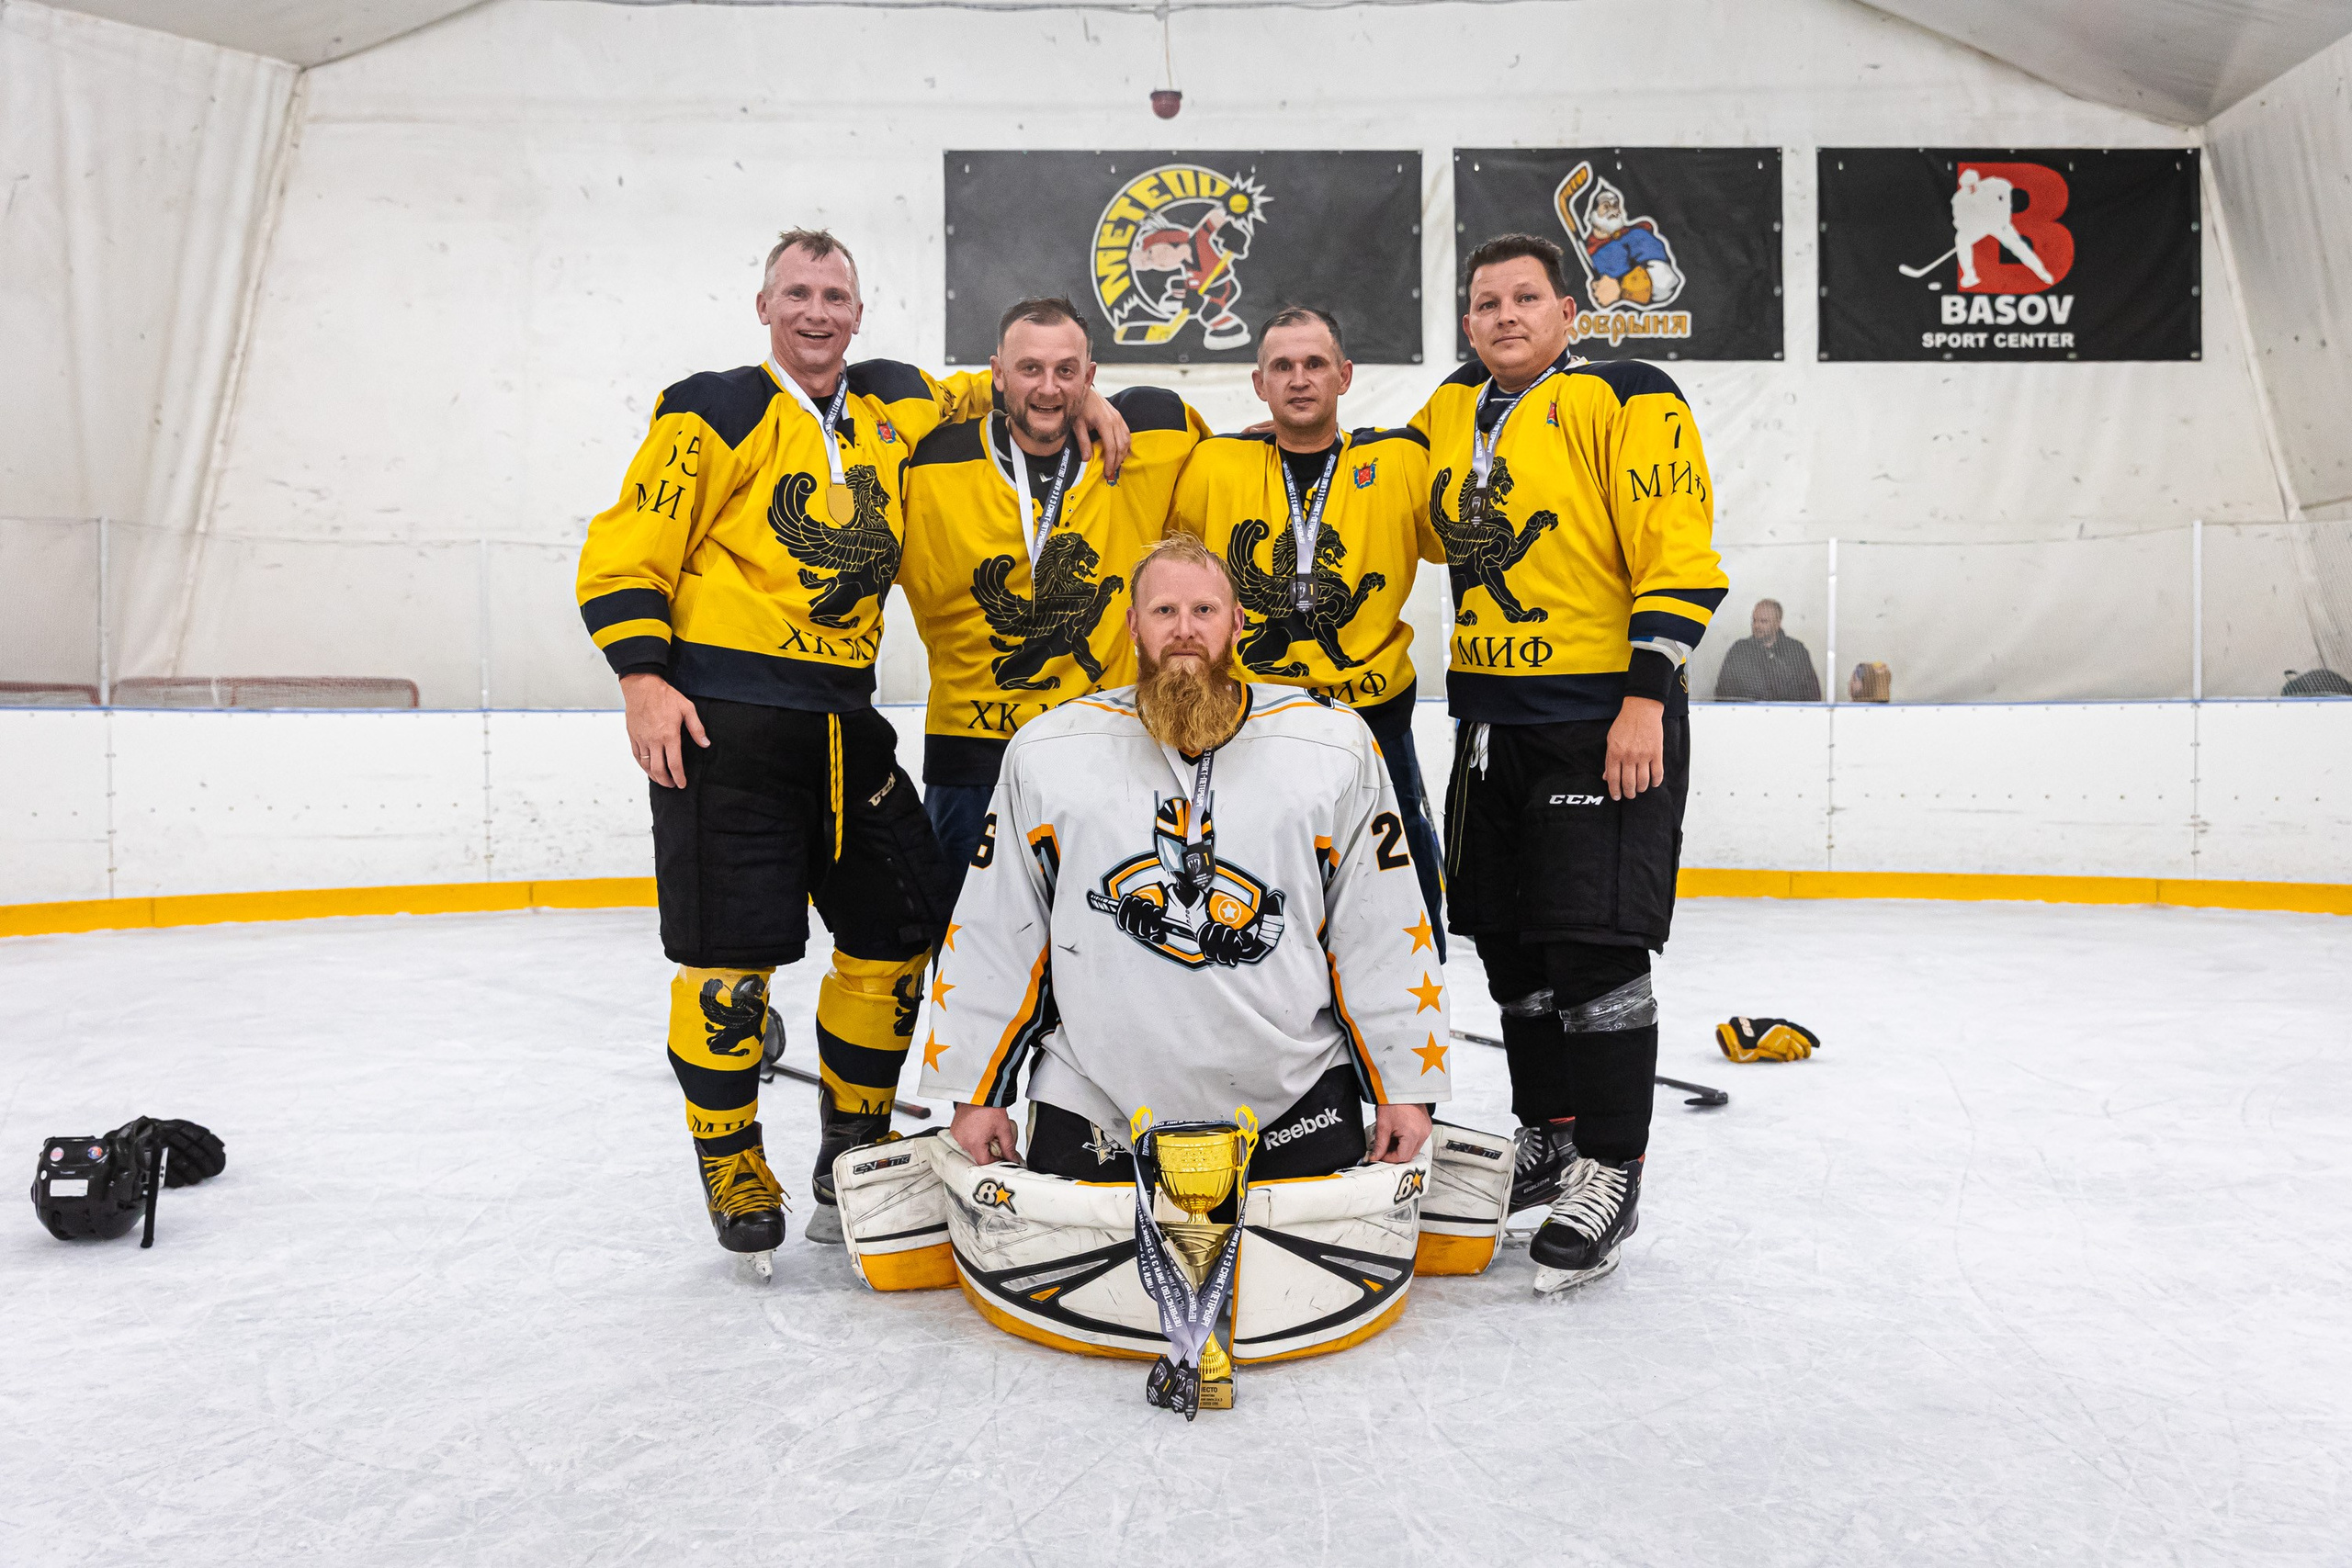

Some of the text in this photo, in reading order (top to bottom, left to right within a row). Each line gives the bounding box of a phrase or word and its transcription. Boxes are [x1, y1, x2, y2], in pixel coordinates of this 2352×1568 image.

[1941, 295, 2075, 325] BASOV
[1922, 333, 2075, 348] SPORT CENTER
[1309, 583, 1314, 596] 1
[1457, 636, 1554, 668] МИФ
[1319, 670, 1387, 704] ИФ
[967, 700, 1022, 733] ХК
[1549, 794, 1604, 806] CCM
[1203, 852, 1210, 866] 1
[1263, 1108, 1343, 1151] Reebok
[1230, 1229, 1239, 1247] ЛИГИ
[1154, 1266, 1166, 1284] ЛИГИ
[1160, 1285, 1182, 1327] ПЕРВЕНСТВО
[1200, 1266, 1228, 1326] САНКТ-ПЕТЕРБУРГ
